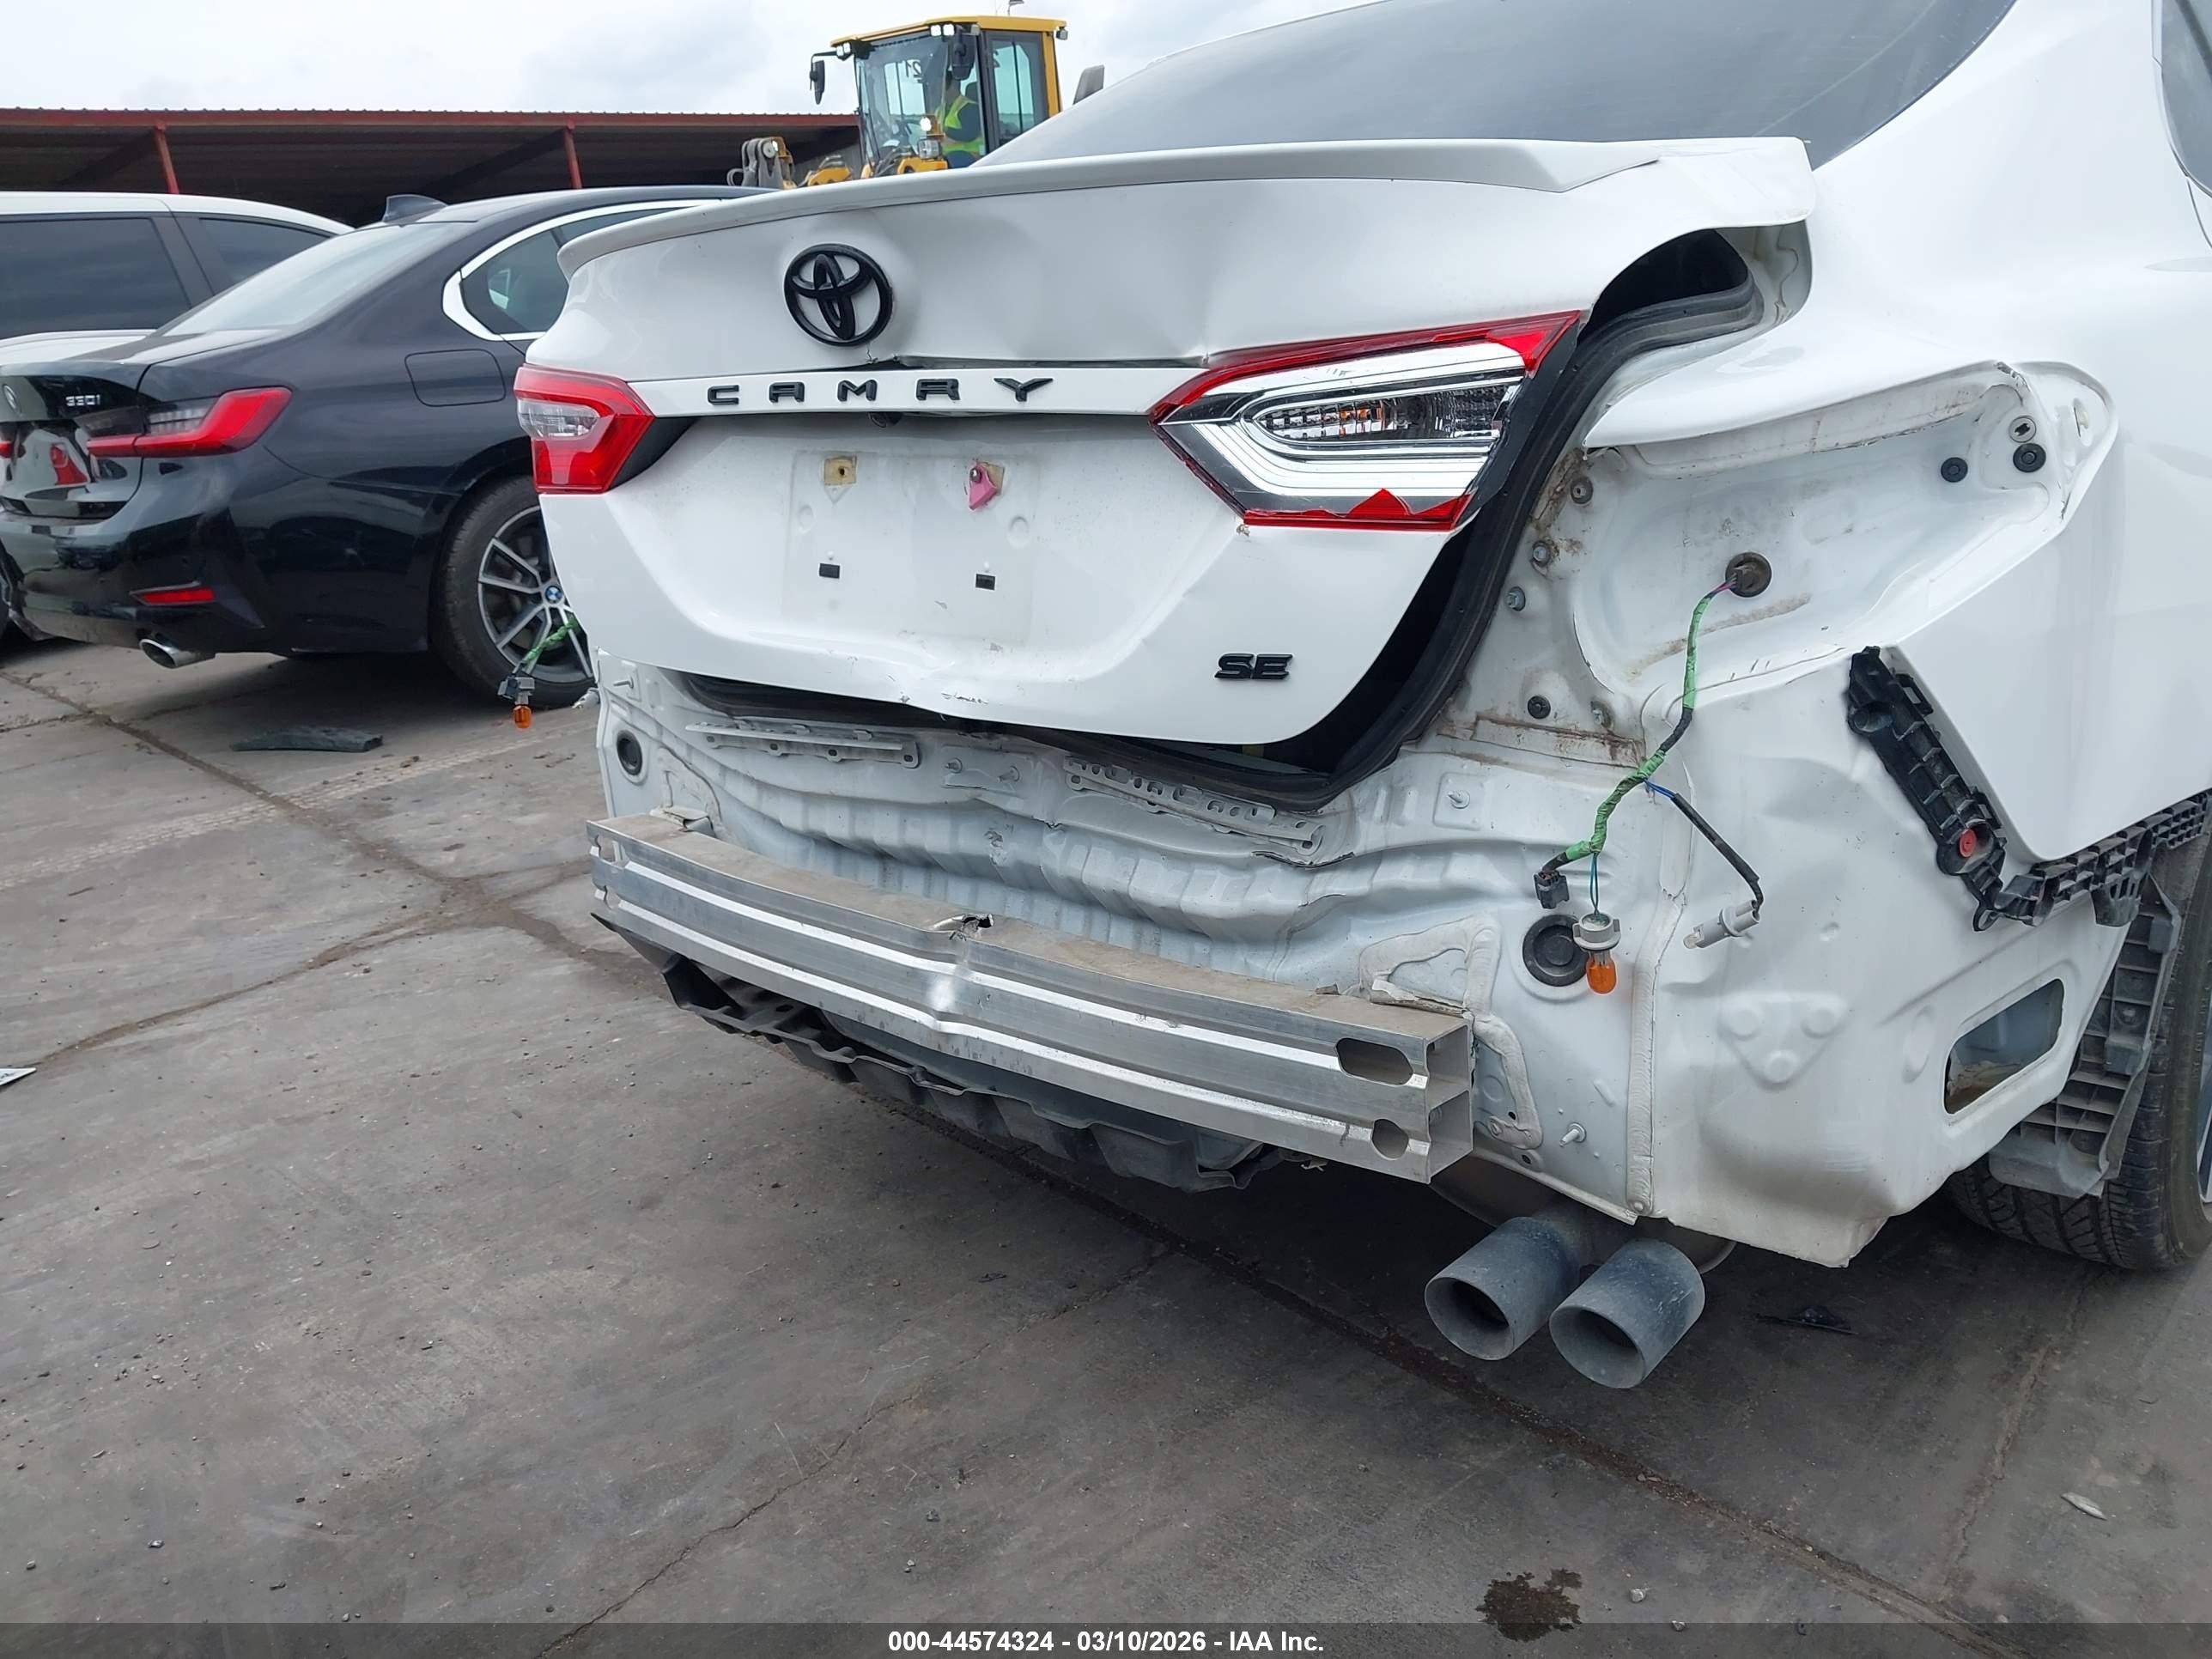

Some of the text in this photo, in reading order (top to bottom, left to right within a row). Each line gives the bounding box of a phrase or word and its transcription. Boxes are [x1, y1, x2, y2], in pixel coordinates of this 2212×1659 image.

[65, 394, 100, 407] 330i
[707, 377, 1054, 406] CAMRY
[1214, 653, 1293, 680] SE
